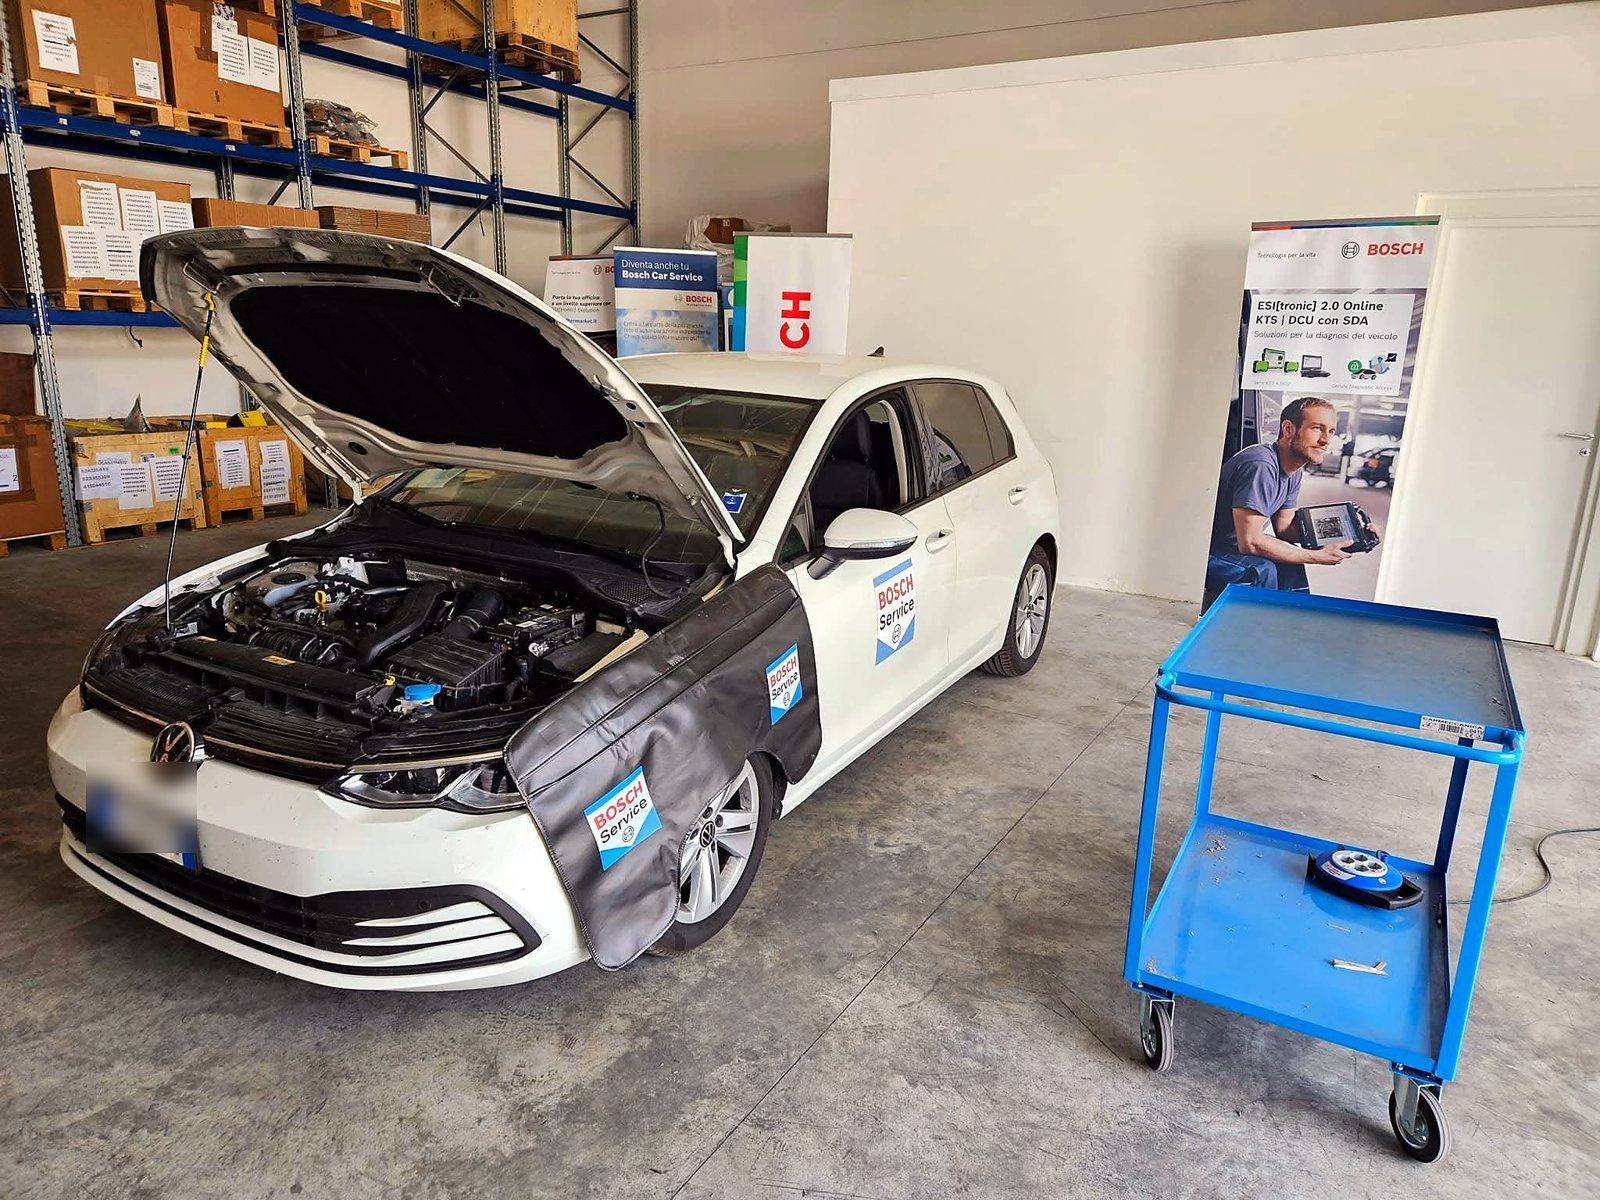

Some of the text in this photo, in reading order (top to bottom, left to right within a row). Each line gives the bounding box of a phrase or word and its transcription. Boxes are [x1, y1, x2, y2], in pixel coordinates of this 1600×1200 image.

[1257, 252, 1287, 260] Tecnologia
[1305, 251, 1317, 259] vita
[1367, 242, 1424, 256] BOSCH
[621, 259, 690, 271] Diventa anche tu
[622, 270, 703, 282] Bosch Car Service
[685, 295, 713, 304] BOSCH
[1257, 300, 1384, 312] ESI[tronic] 2.0 Online
[1255, 315, 1278, 325] KTS
[1288, 315, 1314, 325] DCU
[1318, 317, 1339, 325] con
[1342, 315, 1369, 326] SDA
[1253, 331, 1398, 341] Soluzioni per la diagnosi del veicolo
[877, 573, 915, 611] BOSCH
[878, 597, 916, 631] Service
[769, 656, 798, 689] BOSCH
[771, 670, 799, 700] Service
[593, 780, 643, 831] BOSCH
[600, 798, 648, 843] Service
